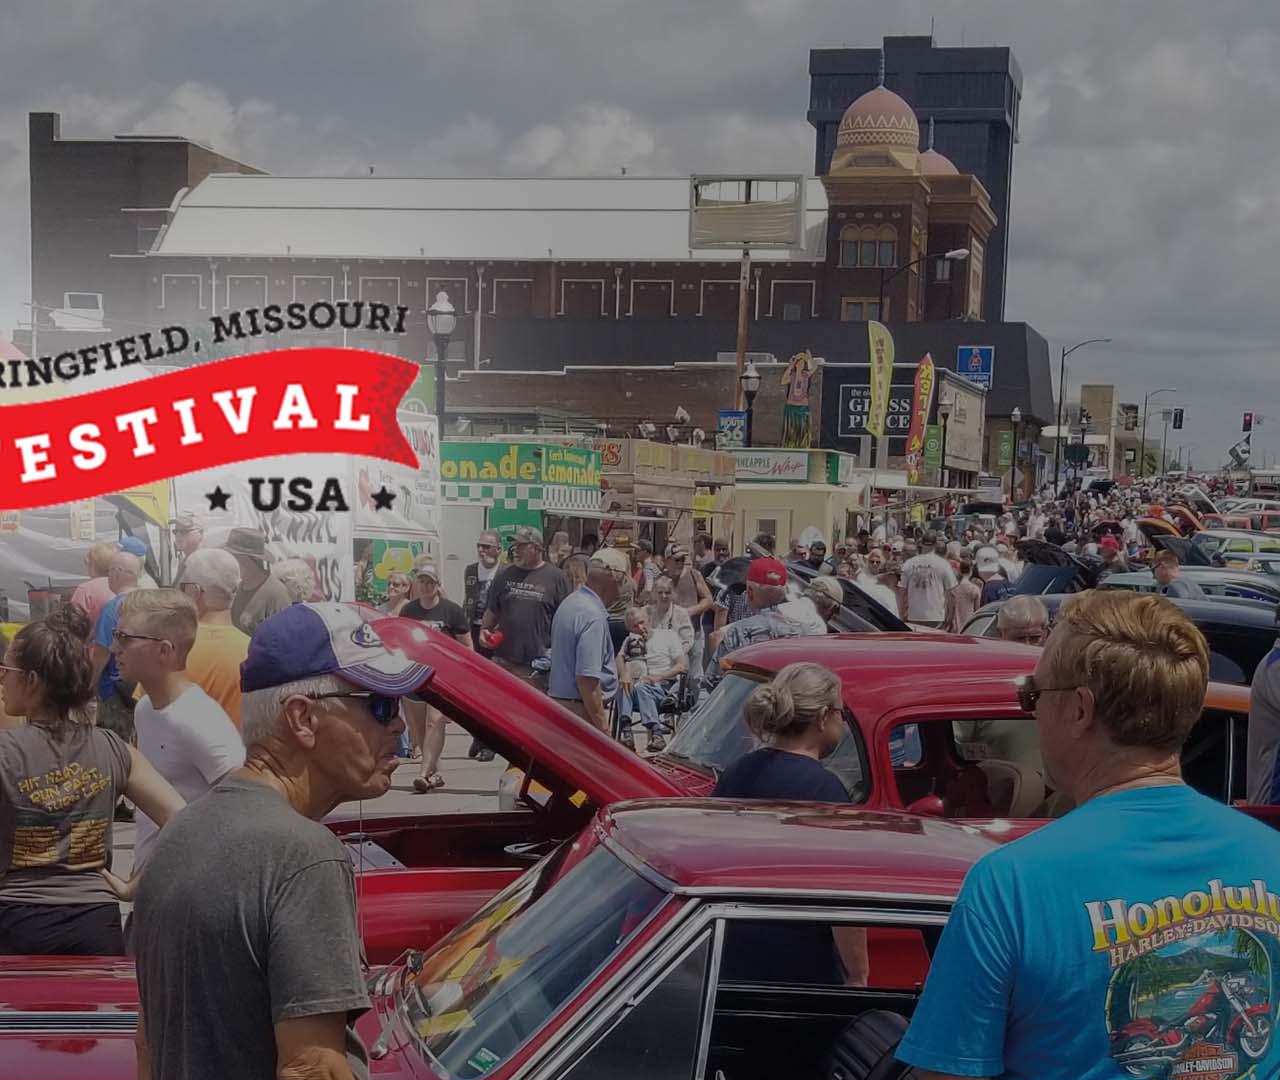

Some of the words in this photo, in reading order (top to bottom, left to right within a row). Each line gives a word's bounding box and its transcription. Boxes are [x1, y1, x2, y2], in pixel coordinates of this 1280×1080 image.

[848, 398, 911, 412] GLSS
[847, 414, 911, 429] PLCE
[441, 445, 537, 481] onade
[541, 446, 601, 487] Lemonade
[17, 776, 41, 793] HIT
[29, 785, 60, 804] RUN
